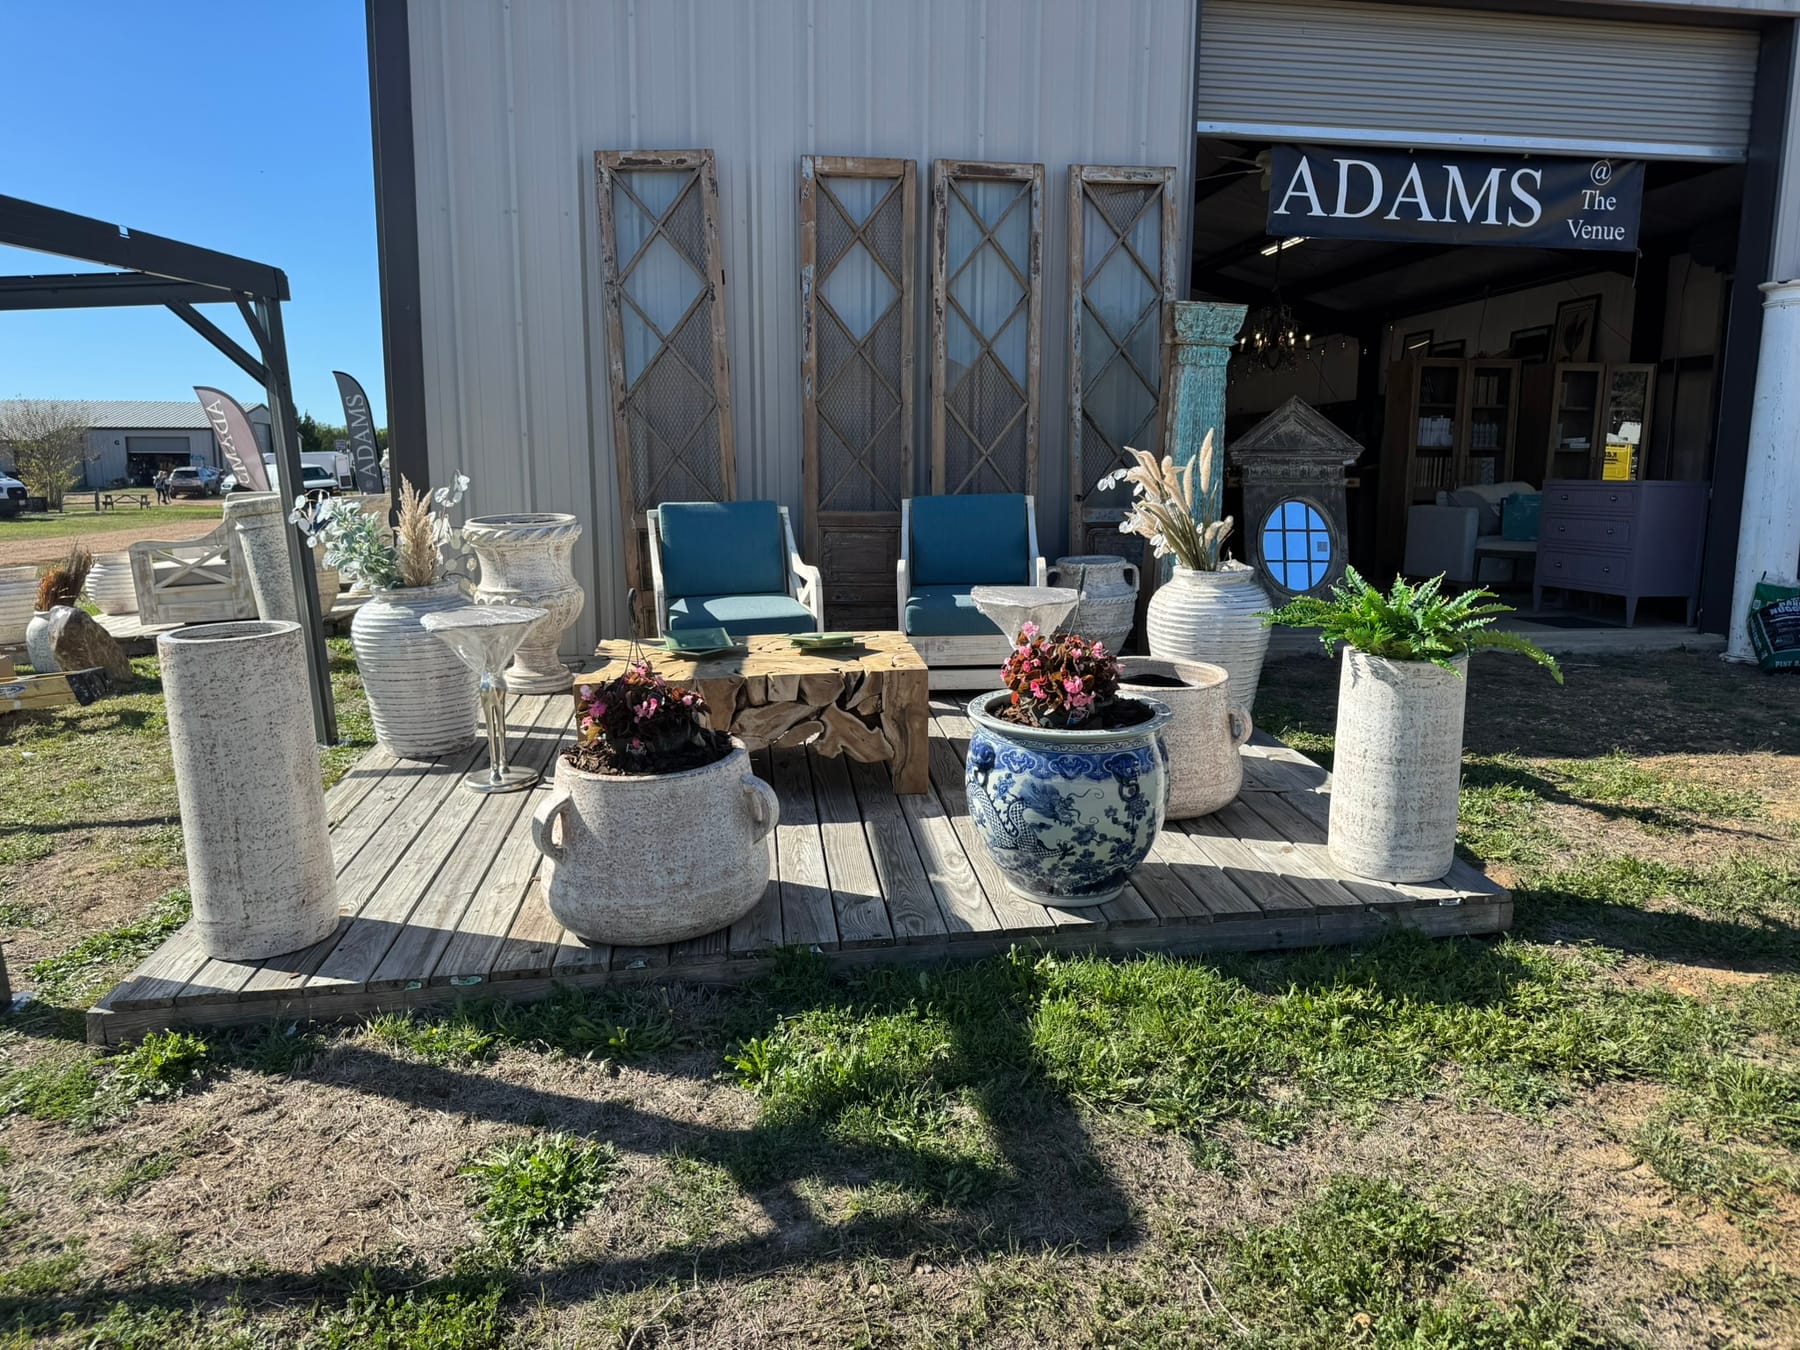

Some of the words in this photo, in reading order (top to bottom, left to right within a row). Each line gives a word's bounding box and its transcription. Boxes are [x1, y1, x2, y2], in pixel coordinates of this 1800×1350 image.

[1589, 160, 1612, 186] @
[1273, 154, 1543, 228] ADAMS
[1581, 189, 1617, 211] The
[1566, 219, 1626, 241] Venue
[345, 394, 377, 477] ADAMS
